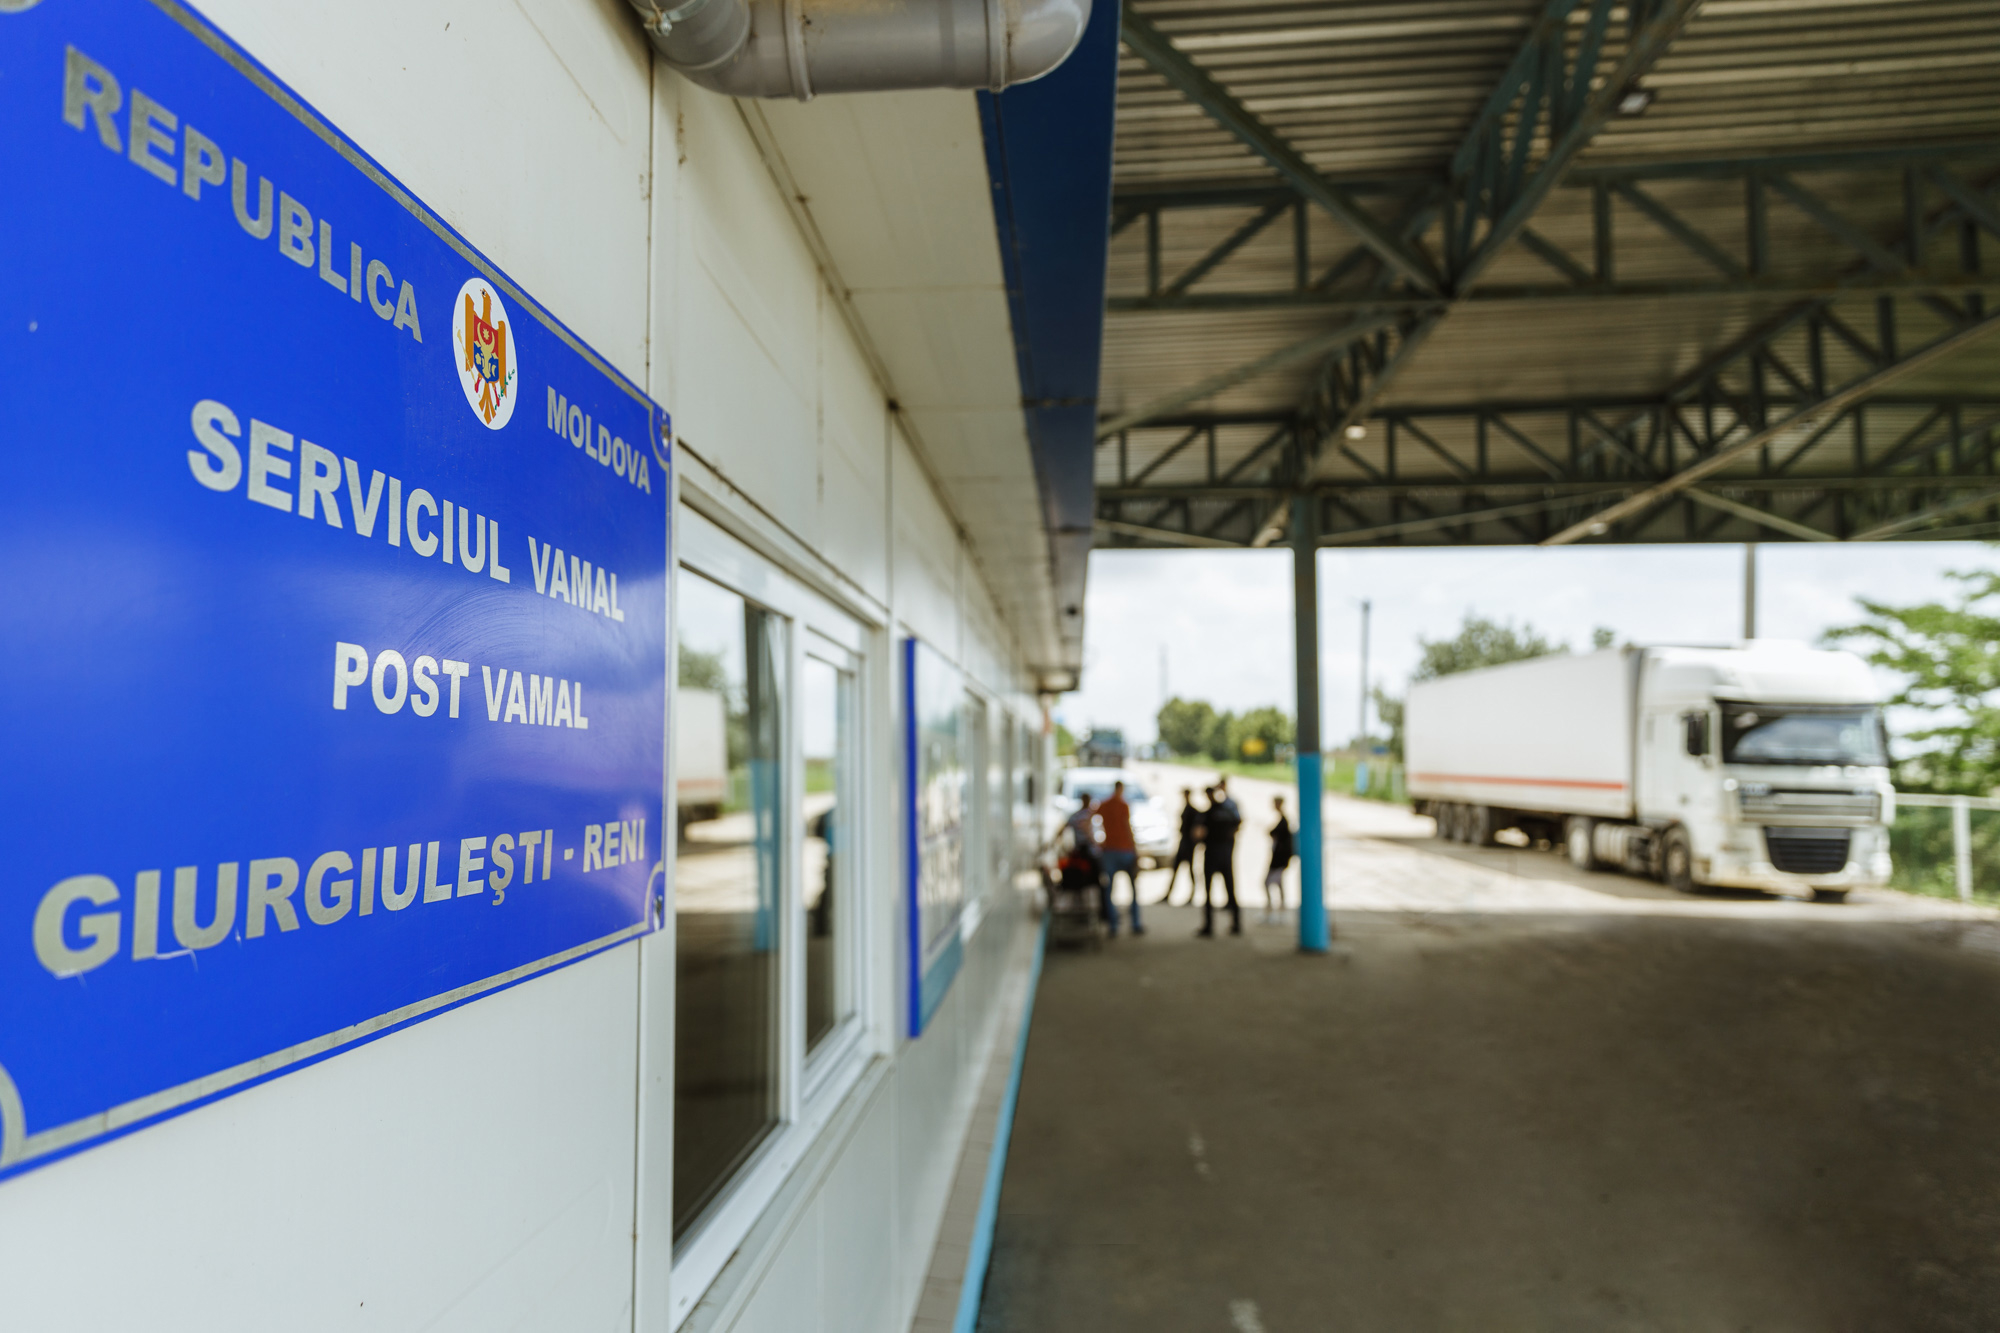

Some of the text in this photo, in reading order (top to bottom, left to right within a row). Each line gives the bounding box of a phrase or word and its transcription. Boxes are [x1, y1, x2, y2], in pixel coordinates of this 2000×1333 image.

[62, 44, 652, 495] REPUBLICA MOLDOVA
[187, 399, 625, 623] SERVICIUL VAMAL
[332, 641, 589, 729] POST VAMAL
[583, 818, 646, 873] RENI
